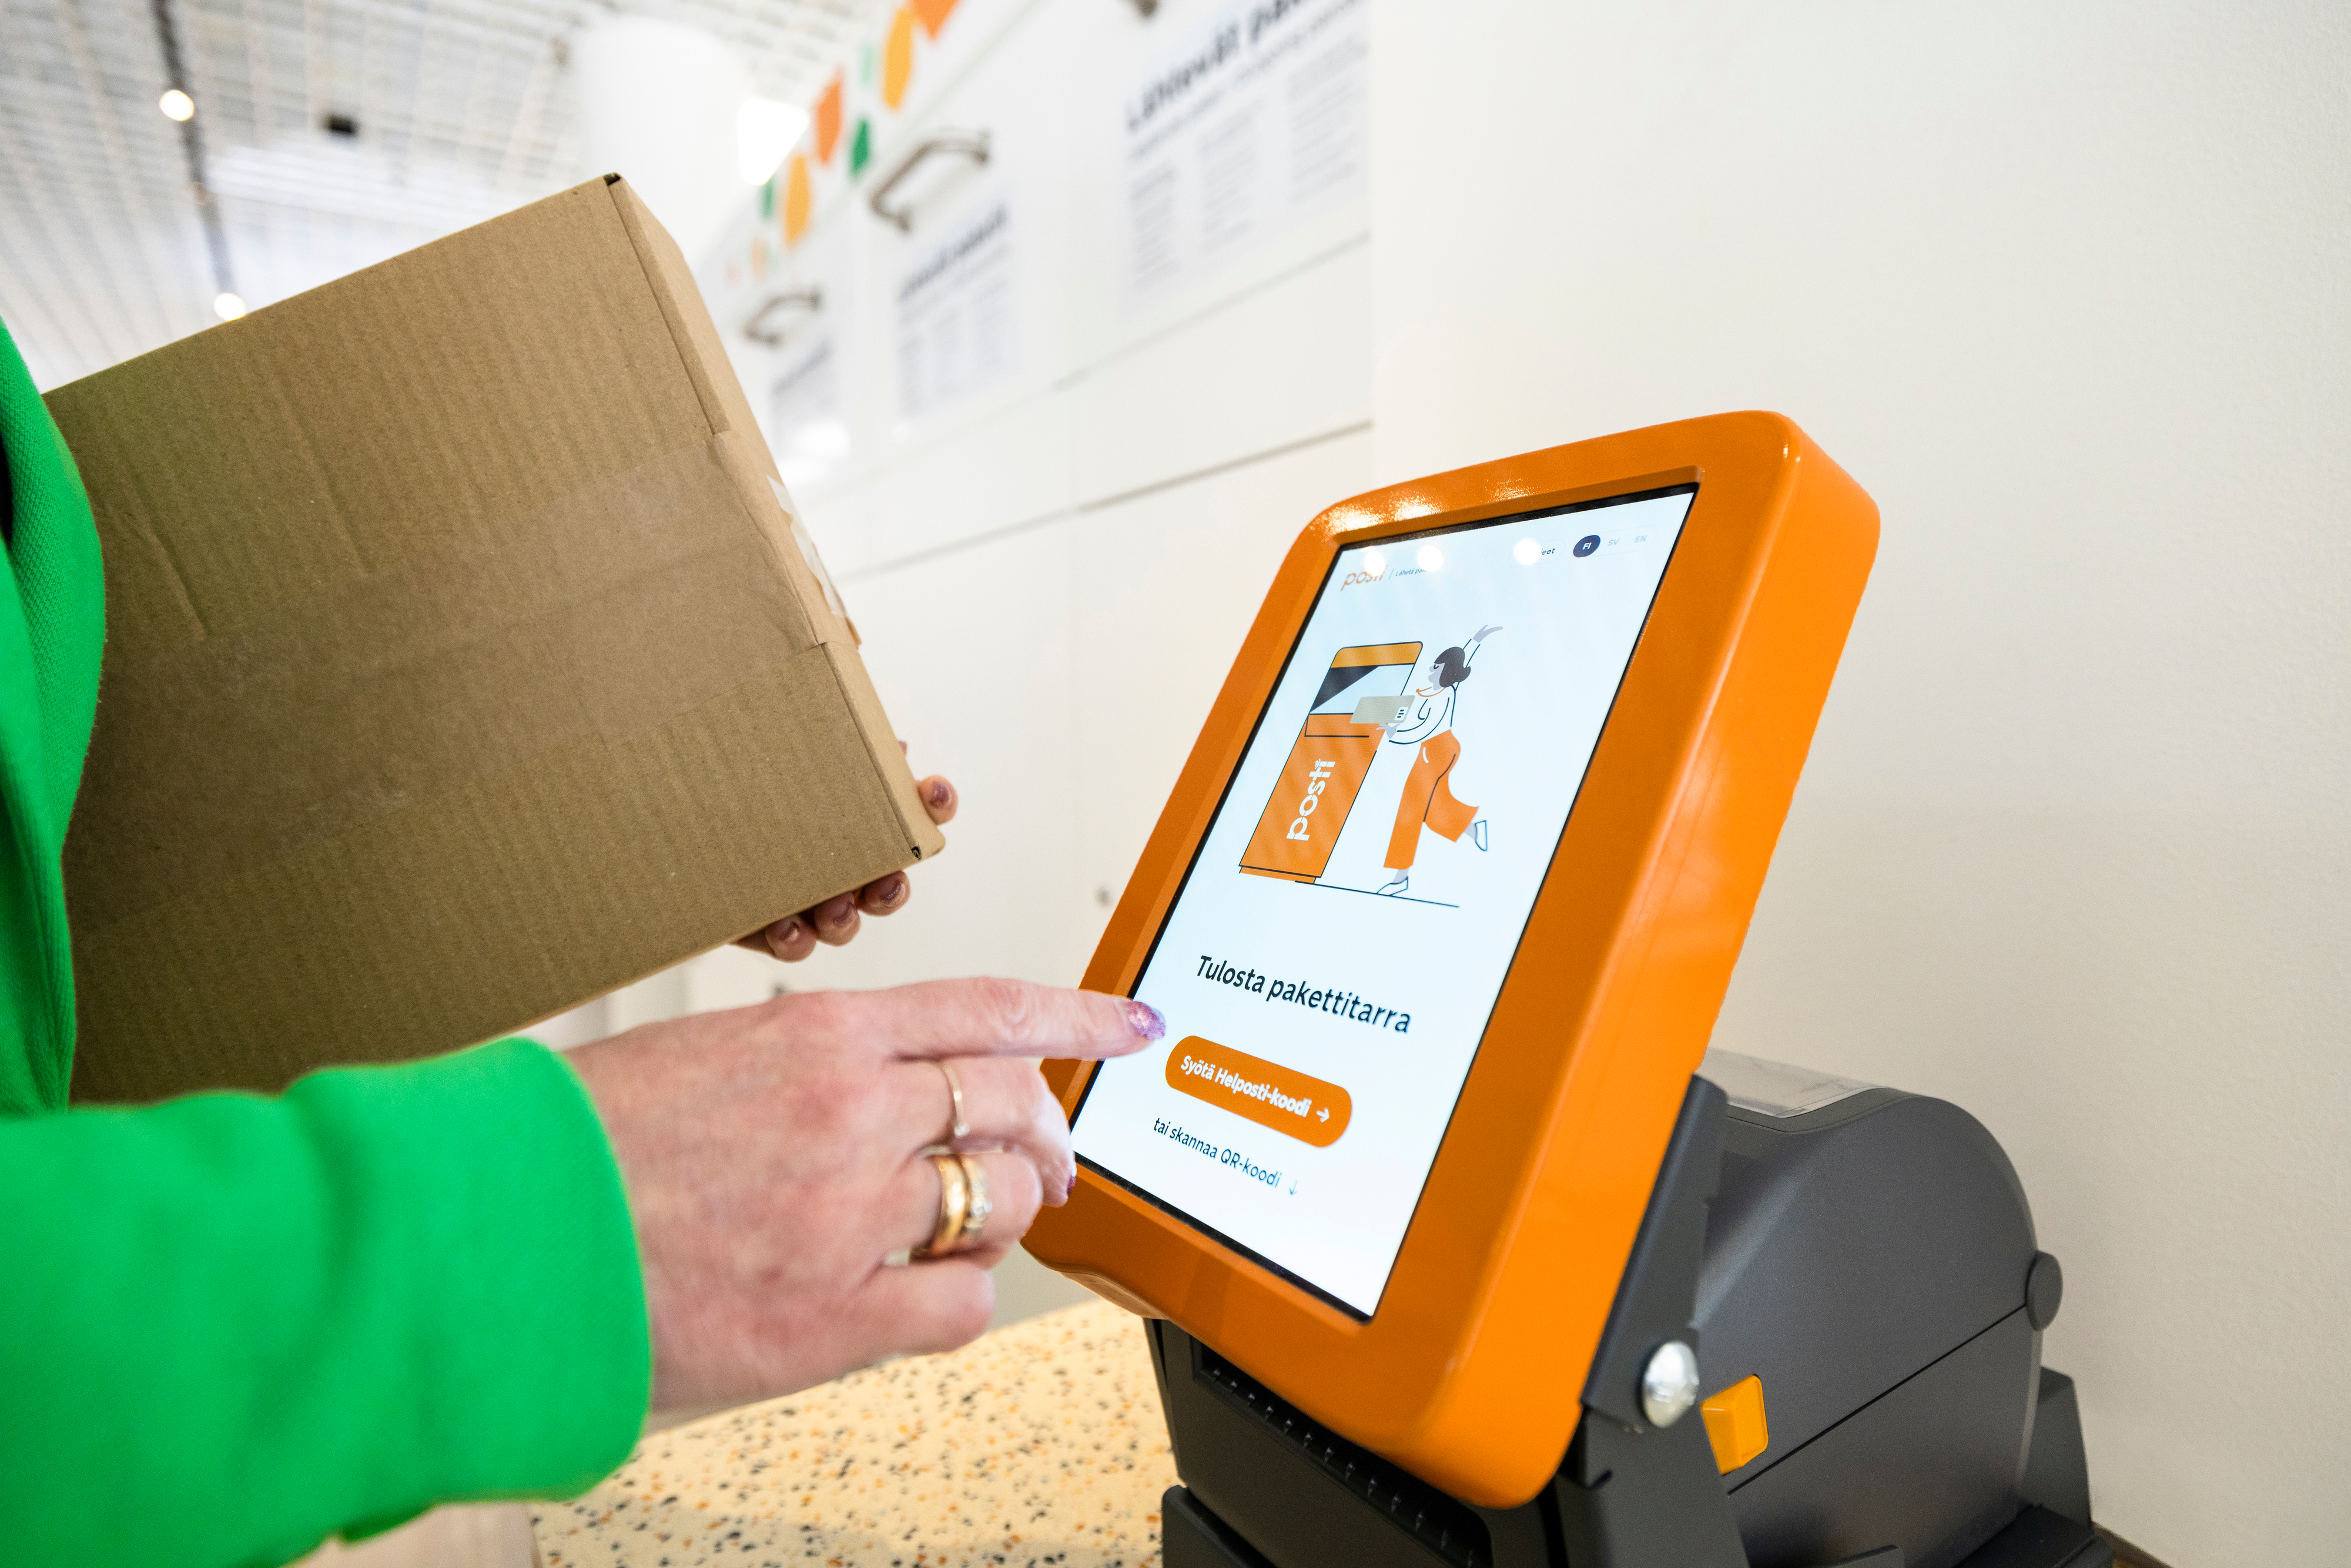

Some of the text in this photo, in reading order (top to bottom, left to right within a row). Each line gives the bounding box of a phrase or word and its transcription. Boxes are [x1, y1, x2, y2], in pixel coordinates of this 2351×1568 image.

[1635, 535, 1648, 543] EN
[1286, 759, 1336, 841] posti
[1197, 955, 1412, 1033] Tulosta pakettitarra
[1180, 1055, 1312, 1118] Syötä Helposti-koodi
[1153, 1117, 1282, 1188] tai skannaa QR-koodi
